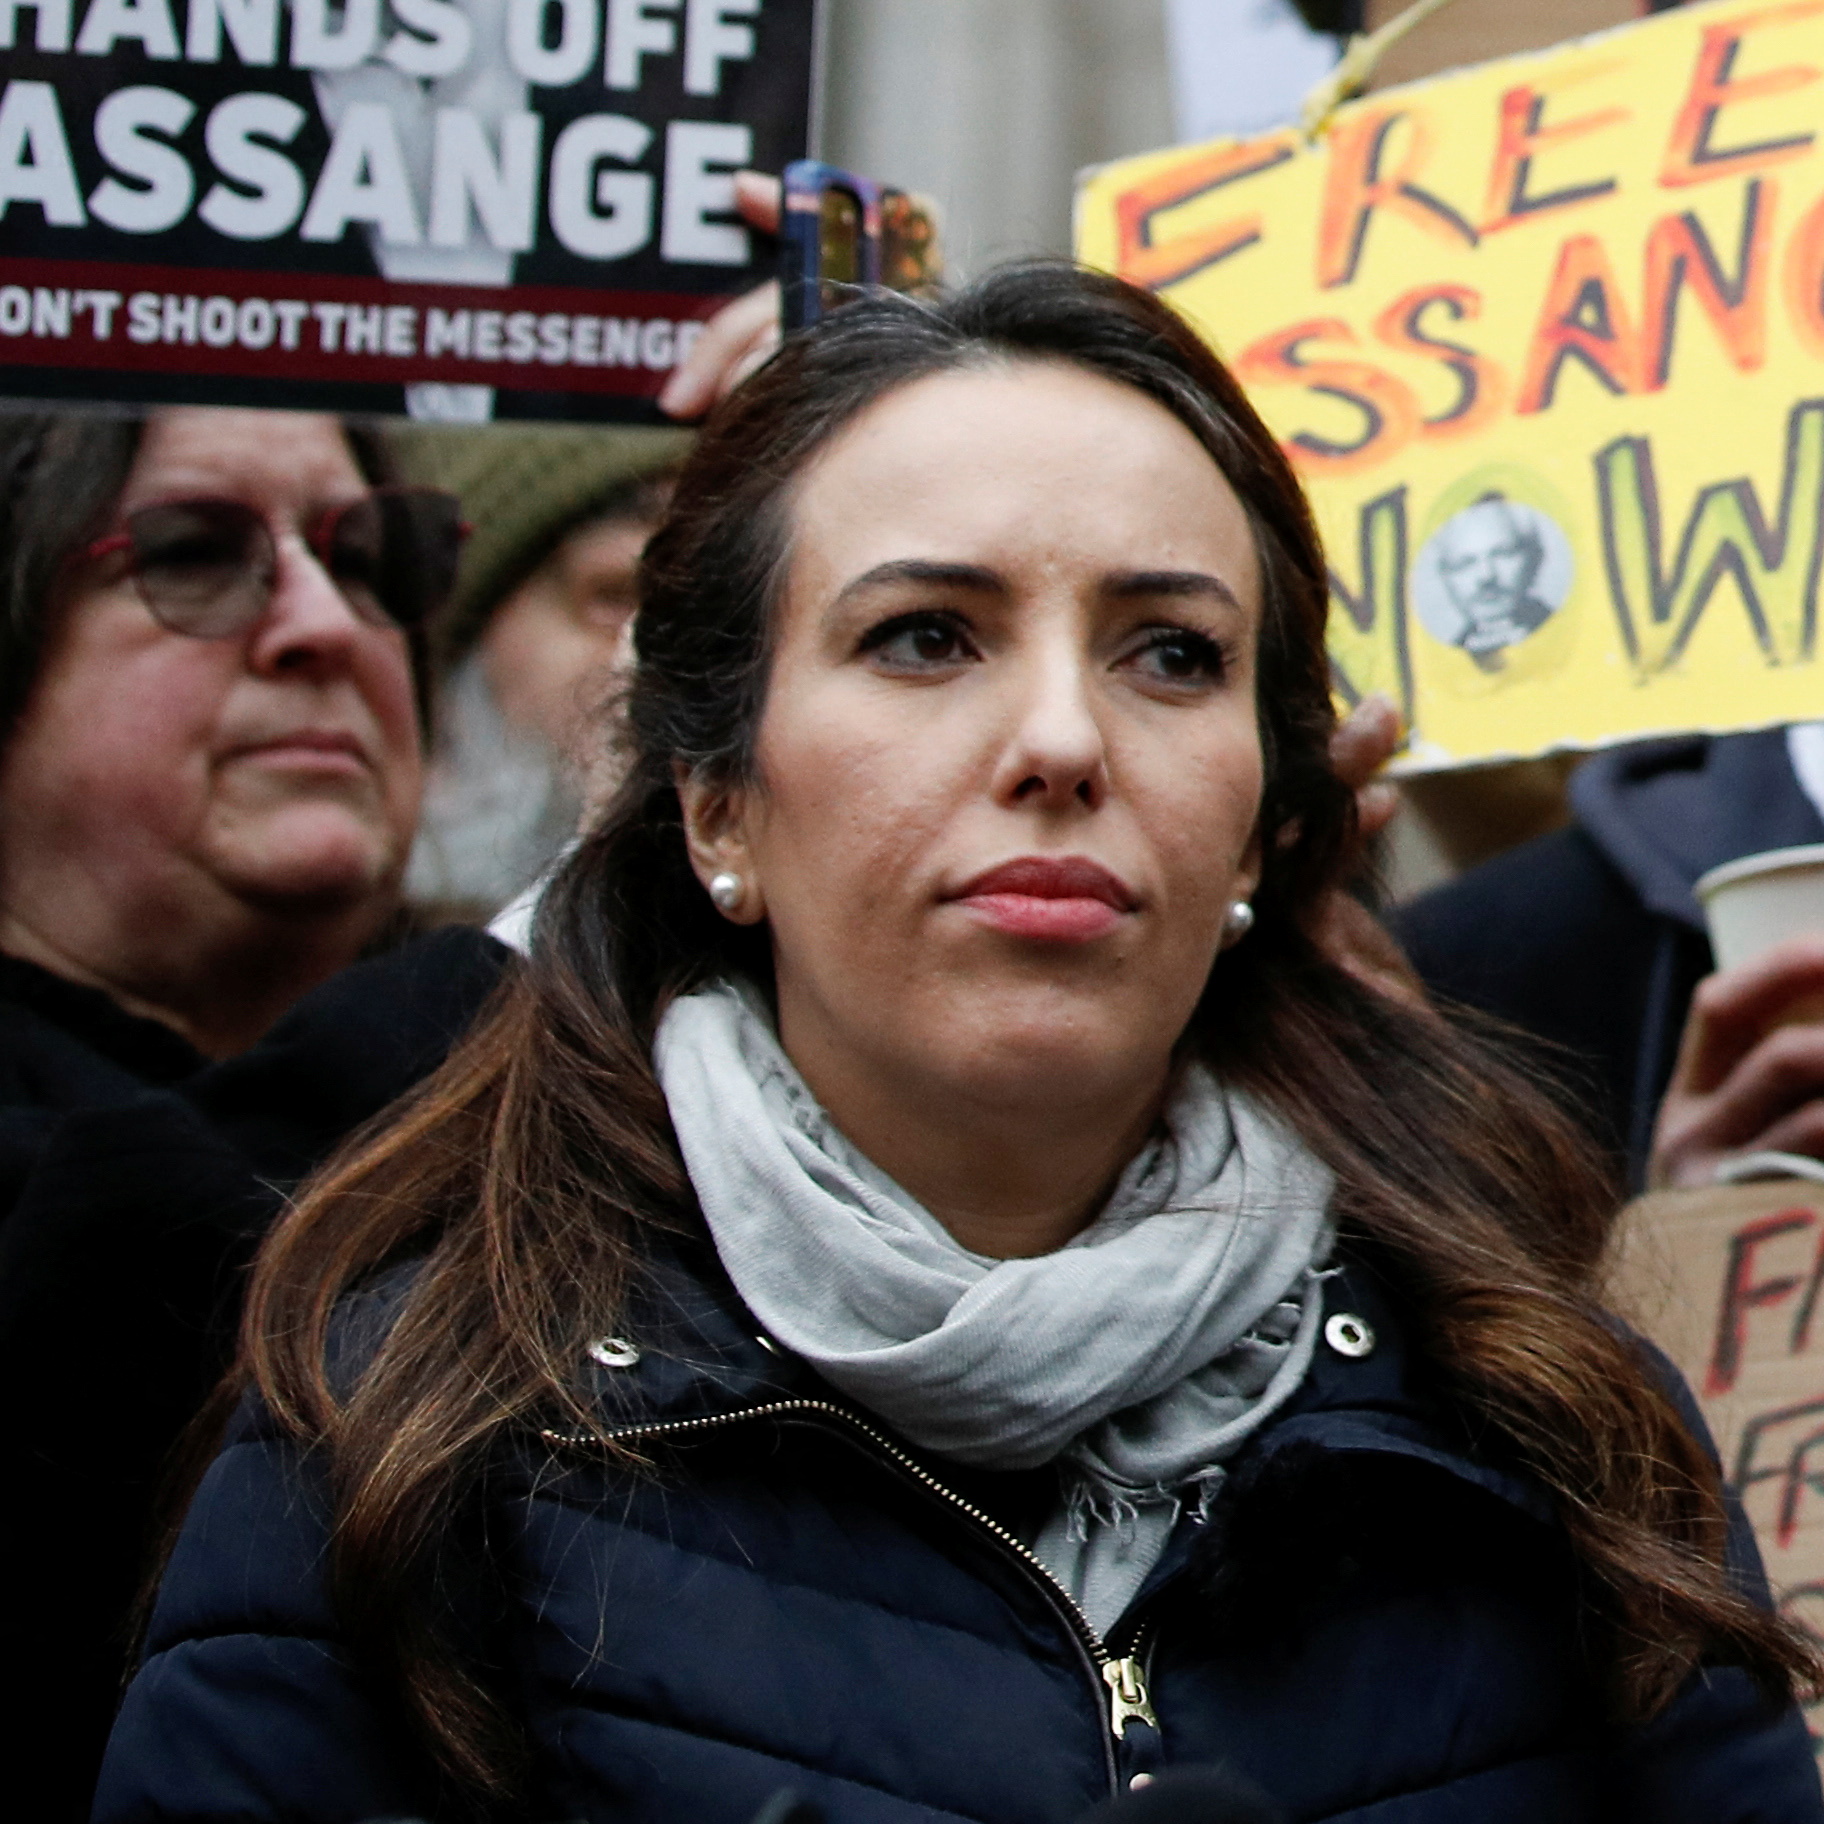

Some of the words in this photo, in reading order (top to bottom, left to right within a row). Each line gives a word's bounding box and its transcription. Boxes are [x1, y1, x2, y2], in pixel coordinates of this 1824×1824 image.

[0, 80, 753, 266] ASSANGE
[127, 293, 309, 351] SHOOT
[312, 302, 420, 356] THE
